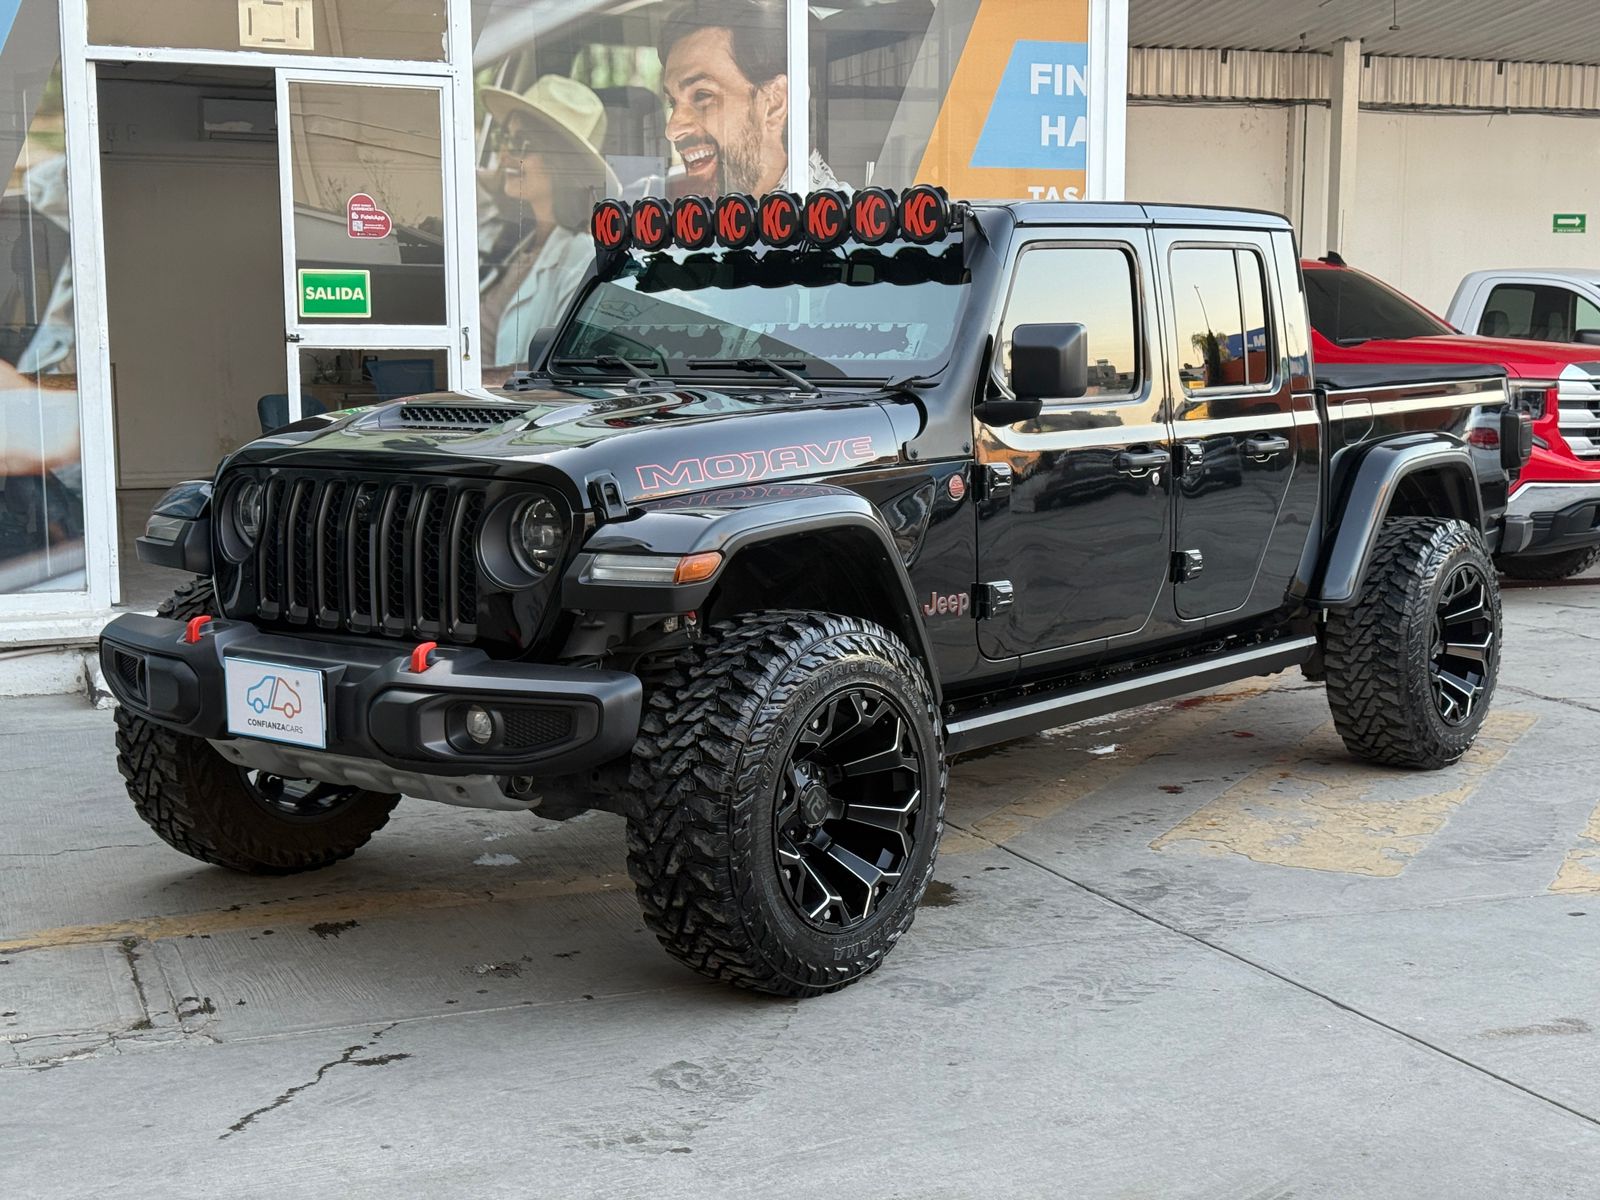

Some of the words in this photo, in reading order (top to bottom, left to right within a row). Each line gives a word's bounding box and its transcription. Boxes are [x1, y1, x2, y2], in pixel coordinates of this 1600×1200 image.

[1027, 186, 1087, 200] TAS
[595, 206, 621, 246] KC
[635, 204, 661, 244] KC
[676, 202, 703, 243] KC
[718, 200, 746, 241] KC
[763, 198, 791, 240] KC
[808, 196, 838, 239] KC
[855, 195, 886, 237] KC
[904, 192, 936, 237] KC
[305, 286, 365, 300] SALIDA
[634, 436, 875, 490] MOJAVE
[923, 591, 969, 616] Jeep
